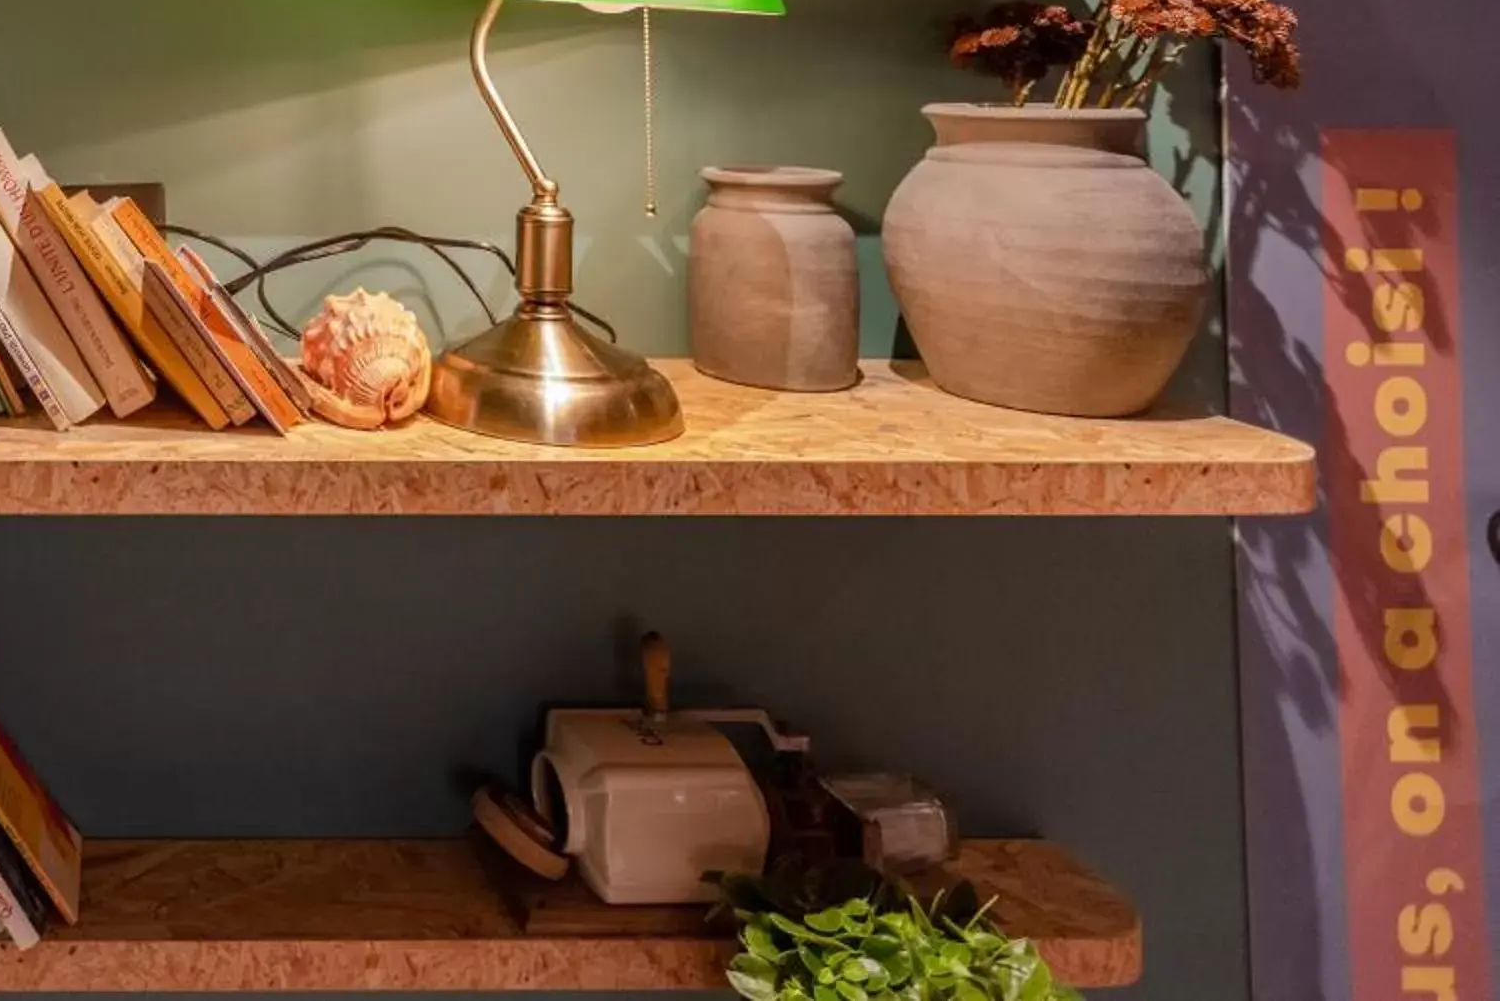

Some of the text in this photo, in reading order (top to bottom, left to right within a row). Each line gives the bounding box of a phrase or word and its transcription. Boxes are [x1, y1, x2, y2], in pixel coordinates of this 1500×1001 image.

[1344, 245, 1433, 573] choisi
[1381, 607, 1438, 672] a
[1388, 703, 1447, 838] on
